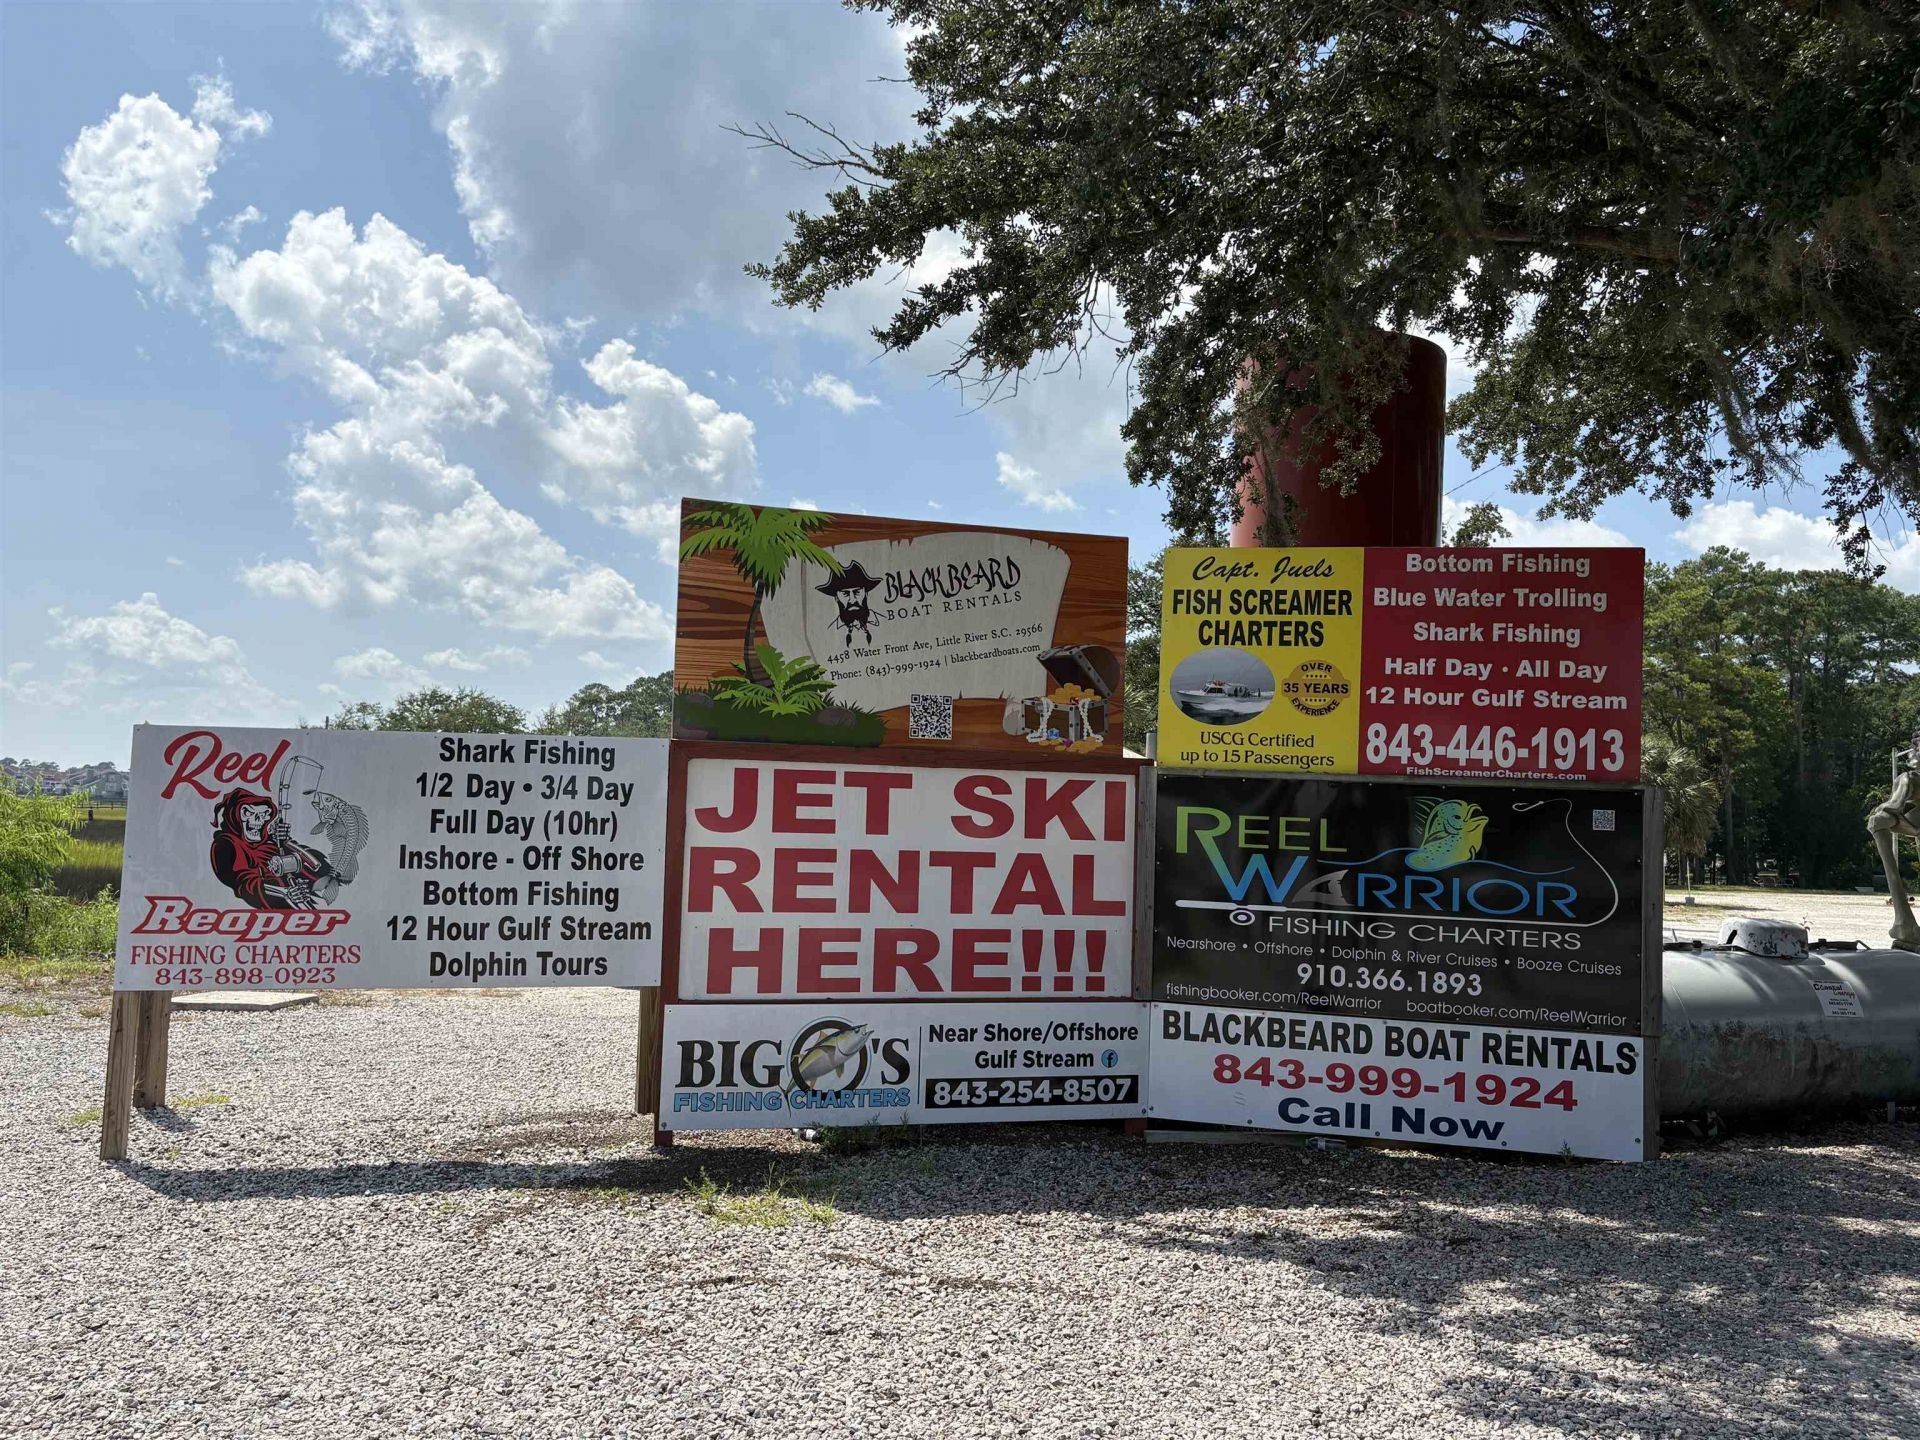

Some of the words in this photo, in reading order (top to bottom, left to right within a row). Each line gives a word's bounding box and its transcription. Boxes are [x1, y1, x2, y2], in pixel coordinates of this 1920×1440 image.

[883, 556, 1021, 604] BLACKBEARD
[1192, 556, 1259, 583] Capt.
[1271, 556, 1336, 584] Juels
[1406, 554, 1494, 573] Bottom
[1502, 554, 1591, 577] Fishing
[887, 603, 933, 621] BOAT
[943, 591, 1022, 613] RENTALS
[1172, 589, 1221, 615] FISH
[1229, 589, 1353, 616] SCREAMER
[1374, 587, 1426, 607] Blue
[1433, 588, 1506, 607] Water
[1512, 588, 1608, 612] Trolling
[827, 649, 850, 664] 4458
[852, 644, 882, 659] Water
[884, 641, 910, 655] Front
[912, 635, 933, 650] Ave,
[936, 633, 961, 647] Little
[963, 629, 988, 643] River
[990, 627, 1012, 638] S.C.
[1015, 623, 1043, 637] 29566
[1198, 619, 1325, 647] CHARTERS
[1413, 622, 1484, 642] Shark
[1492, 623, 1582, 648] Fishing
[831, 665, 862, 680] Phone:
[865, 657, 941, 677] (843)-999-1924
[951, 642, 1041, 665] blackbeardboats.com
[1301, 662, 1333, 673] OVER
[1385, 658, 1436, 676] Half
[1444, 658, 1493, 680] Day
[1516, 660, 1550, 678] All
[1559, 660, 1608, 683] Day
[1283, 682, 1300, 694] 35
[1303, 682, 1349, 695] YEARS
[1365, 688, 1396, 705] 12
[1403, 687, 1465, 706] Hour
[1471, 688, 1524, 708] Gulf
[1533, 691, 1628, 710] Stream
[1290, 697, 1340, 717] EXPERIENCE
[439, 738, 515, 763] Shark
[524, 740, 616, 770] Fishing
[1200, 731, 1244, 747] USCG
[1247, 732, 1315, 749] Certified
[1365, 723, 1625, 772] 843-446-1913
[161, 731, 292, 799] Reel
[1180, 751, 1199, 766] up
[1202, 750, 1220, 763] to
[1222, 749, 1241, 764] 15
[1243, 749, 1335, 769] Passengers
[1406, 766, 1587, 781] FishScreamerCharters.com
[416, 773, 452, 797] 1/2
[466, 774, 515, 804] Day
[540, 775, 578, 799] 3/4
[587, 777, 635, 806] Day
[694, 767, 913, 836] JET
[950, 774, 1127, 842] SKI
[429, 810, 477, 834] Full
[486, 811, 535, 841] Day
[543, 811, 618, 842] (10hr)
[400, 845, 497, 870] Inshore
[522, 846, 563, 870] Off
[571, 846, 644, 870] Shore
[423, 881, 518, 906] Bottom
[527, 882, 619, 912] Fishing
[687, 846, 1127, 917] RENTAL
[130, 895, 351, 942] Reaper
[386, 915, 417, 941] 12
[426, 916, 490, 941] Hour
[497, 915, 550, 941] Gulf
[559, 915, 651, 941] Stream
[1268, 917, 1396, 940] FISHING
[1409, 924, 1582, 950] CHARTERS
[130, 945, 226, 966] FISHING
[235, 945, 361, 965] CHARTERS
[429, 951, 527, 983] Dolphin
[538, 951, 608, 976] Tours
[706, 927, 1107, 994] HERE!!!
[1166, 936, 1237, 952] Nearshore
[1254, 941, 1313, 957] Offshore
[1331, 946, 1387, 963] Dolphin
[1407, 950, 1441, 965] River
[1446, 952, 1498, 968] Cruises
[1517, 956, 1563, 972] Booze
[1568, 959, 1622, 976] Cruises
[154, 966, 336, 985] 843-898-0923
[1296, 964, 1482, 996] 910.366.1893
[1166, 983, 1382, 1010] fishingbooker.com/ReelWarrior
[1407, 1000, 1627, 1027] boatbooker.com/ReelWarrior
[928, 1024, 978, 1042] Near
[984, 1021, 1139, 1044] Shore/Offshore
[1162, 1010, 1374, 1055] BLACKBEARD
[1385, 1027, 1470, 1062] BOAT
[1481, 1033, 1637, 1076] RENTALS
[677, 1039, 783, 1089] BIG
[975, 1050, 1018, 1069] Gulf
[1022, 1050, 1094, 1068] Stream
[933, 1078, 1132, 1105] 843-254-8507
[1212, 1054, 1578, 1112] 843-999-1924
[673, 1091, 782, 1113] FISHING
[790, 1088, 911, 1110] CHARTERS
[1278, 1097, 1369, 1130] Call
[1391, 1108, 1505, 1141] Now
